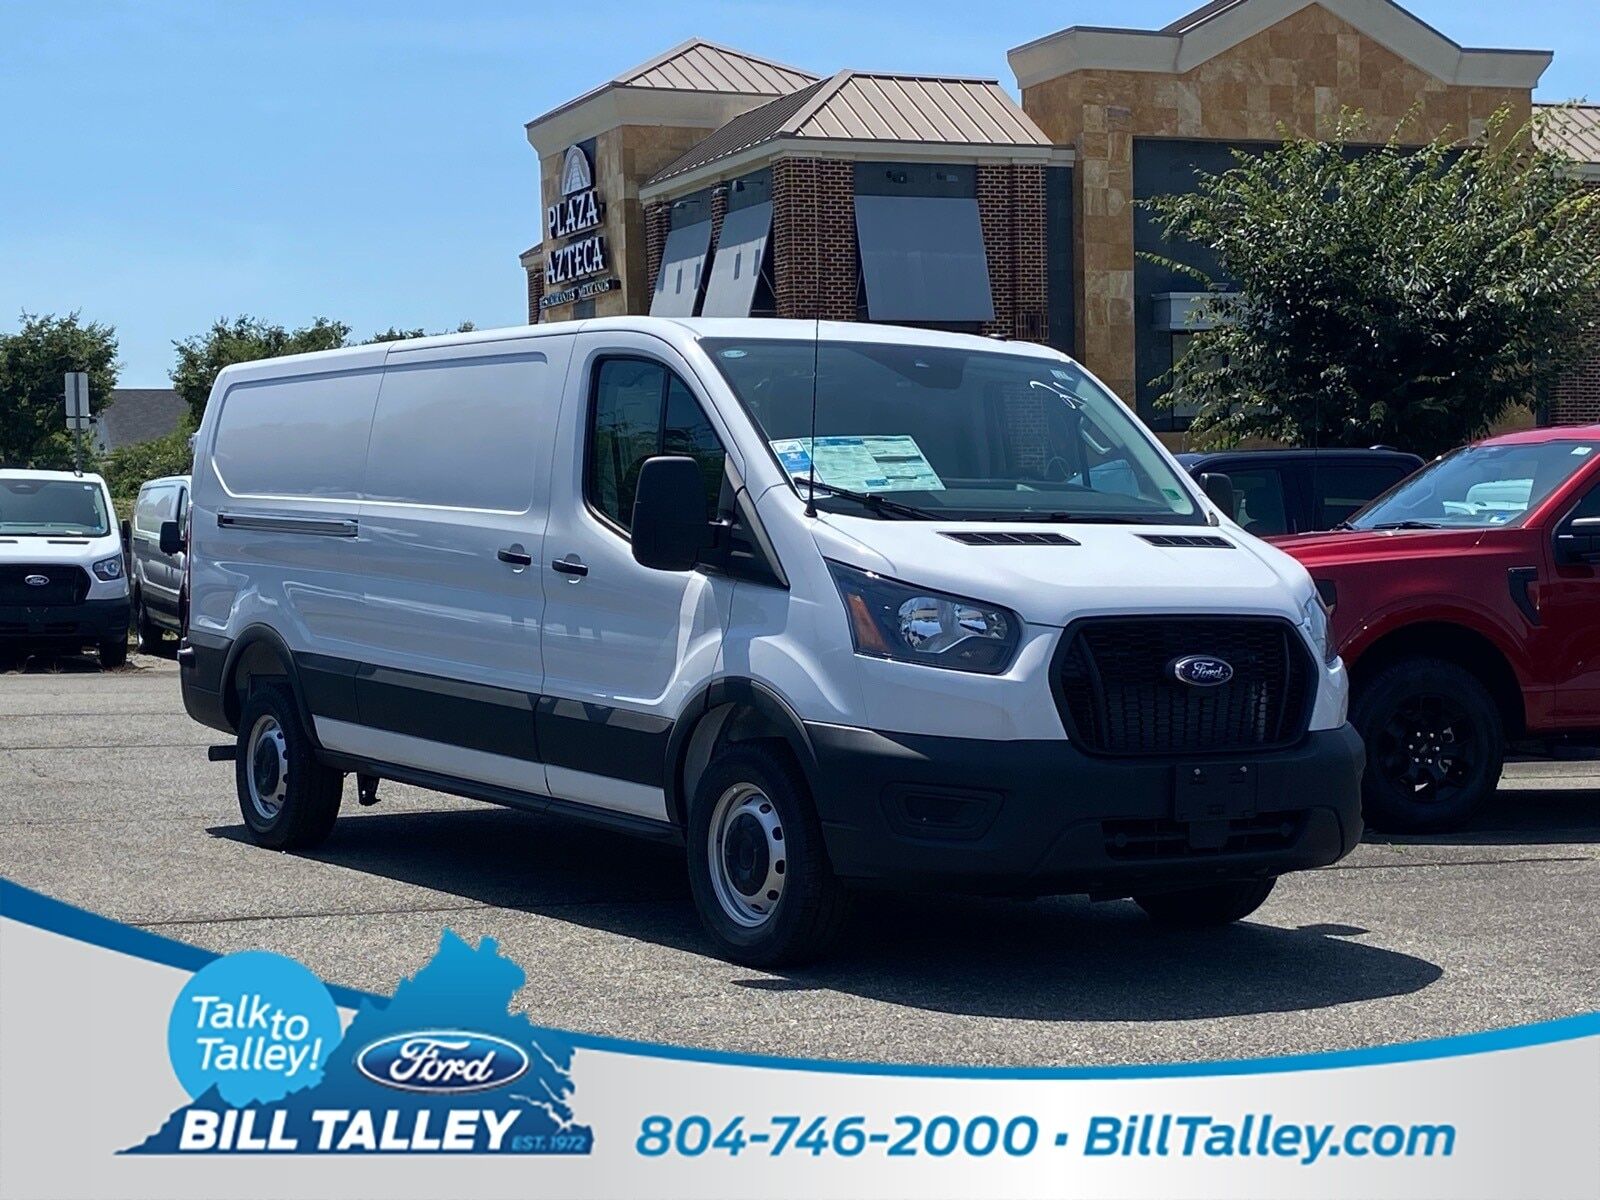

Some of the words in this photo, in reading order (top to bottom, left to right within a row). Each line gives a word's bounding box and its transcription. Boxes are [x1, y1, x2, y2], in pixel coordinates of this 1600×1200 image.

[547, 190, 599, 238] PLAZA
[546, 237, 604, 284] AZTECA
[1192, 662, 1225, 680] Ford
